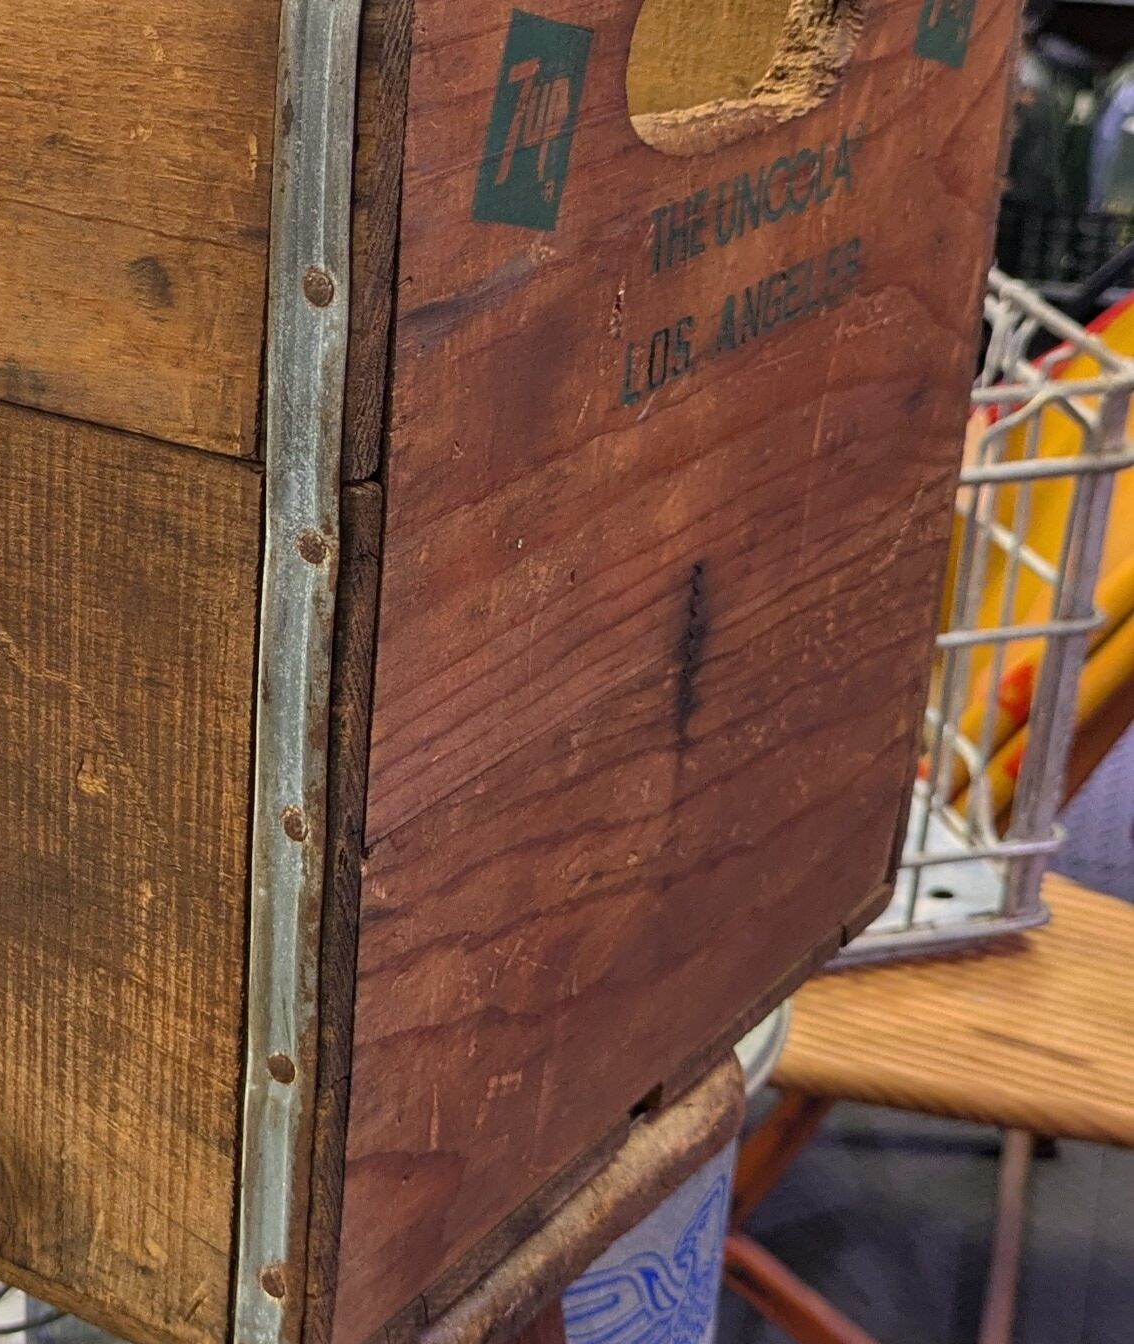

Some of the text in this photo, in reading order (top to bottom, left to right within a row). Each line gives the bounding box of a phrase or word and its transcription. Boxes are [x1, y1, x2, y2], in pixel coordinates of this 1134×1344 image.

[650, 130, 853, 274] THE UNCOLA
[620, 236, 862, 406] LOS ANGELES
